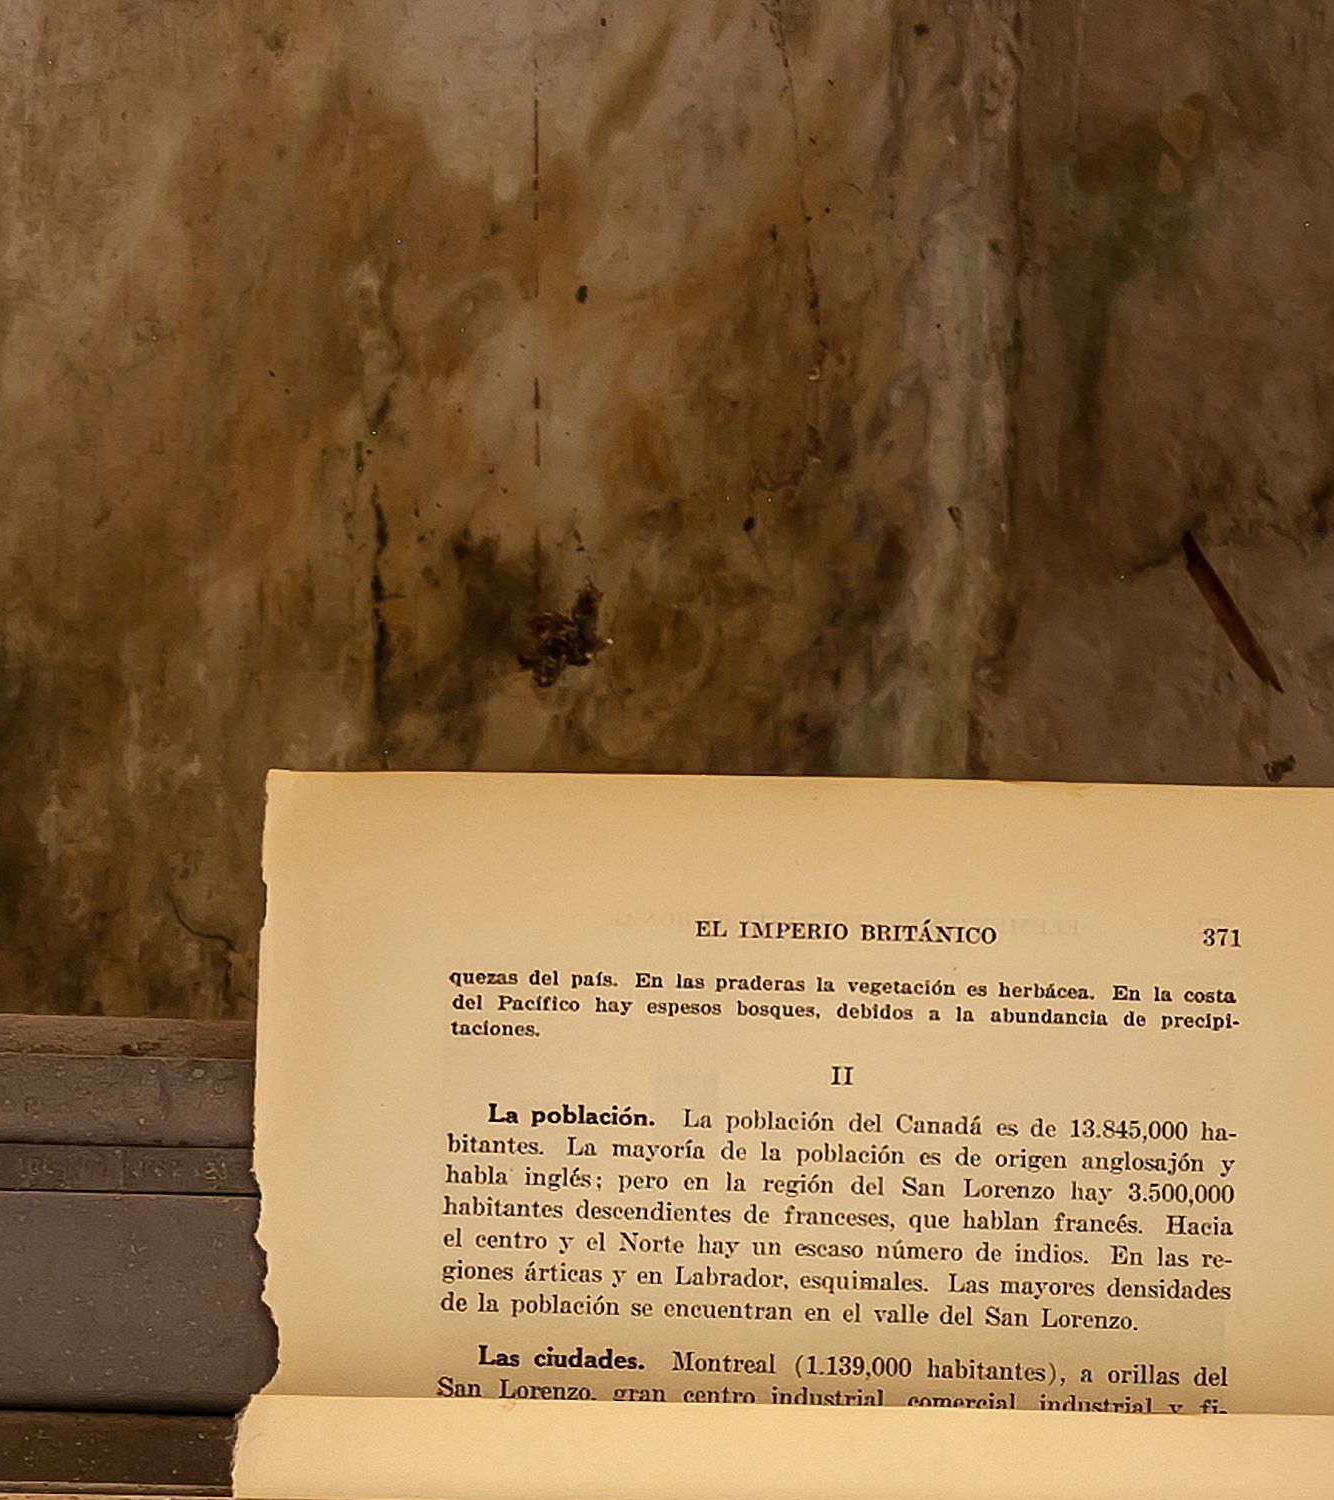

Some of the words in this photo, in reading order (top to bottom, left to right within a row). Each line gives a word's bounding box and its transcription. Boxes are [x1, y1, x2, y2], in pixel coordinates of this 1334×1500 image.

[695, 921, 727, 937] EL
[739, 921, 848, 940] IMPERIO
[860, 918, 996, 944] BRITÁNICO
[1203, 928, 1241, 947] 371
[449, 972, 518, 987] quezas
[529, 970, 559, 986] del
[571, 972, 618, 989] país.
[635, 973, 663, 988] En
[676, 973, 704, 989] las
[715, 975, 805, 992] praderas
[817, 977, 835, 992] la
[848, 980, 955, 996] vegetación
[967, 985, 987, 997] es
[998, 982, 1094, 1000] herbácea.
[1112, 985, 1141, 1001] En
[1154, 986, 1172, 1002] la
[1184, 989, 1236, 1003] costa
[451, 1020, 540, 1037] taciones.
[452, 994, 482, 1010] del
[498, 995, 580, 1012] Pacífico
[596, 997, 633, 1015] hay
[647, 1002, 721, 1017] espesos
[737, 1000, 820, 1020] bosques,
[837, 1003, 913, 1020] debidos
[929, 1010, 940, 1021] a
[956, 1006, 974, 1022] la
[991, 1008, 1108, 1026] abundancia
[1124, 1011, 1146, 1027] de
[1161, 1013, 1239, 1031] precipi-
[831, 1066, 853, 1085] II
[488, 1103, 518, 1124] La
[531, 1105, 655, 1127] población.
[684, 1109, 712, 1128] La
[726, 1109, 834, 1133] población
[849, 1113, 881, 1132] del
[896, 1114, 981, 1135] Canadá
[997, 1123, 1018, 1137] es
[1031, 1118, 1056, 1137] de
[1071, 1119, 1188, 1143] 13.845,000
[1201, 1121, 1236, 1141] ha-
[447, 1134, 543, 1155] bitantes.
[567, 1137, 597, 1156] La
[612, 1139, 705, 1162] mayoría
[721, 1140, 746, 1160] de
[761, 1142, 781, 1161] la
[797, 1142, 905, 1166] población
[920, 1152, 941, 1165] es
[955, 1146, 981, 1167] de
[995, 1149, 1067, 1173] origen
[1082, 1151, 1204, 1176] anglosajón
[1220, 1160, 1235, 1177] y
[445, 1165, 508, 1185] habla
[525, 1167, 601, 1191] inglés;
[619, 1175, 668, 1193] pero
[684, 1177, 708, 1190] en
[726, 1172, 746, 1192] la
[763, 1174, 833, 1197] región
[851, 1175, 883, 1196] del
[902, 1176, 945, 1197] San
[963, 1178, 1054, 1200] Lorenzo
[1071, 1181, 1112, 1205] hay
[1129, 1183, 1234, 1207] 3.500,000
